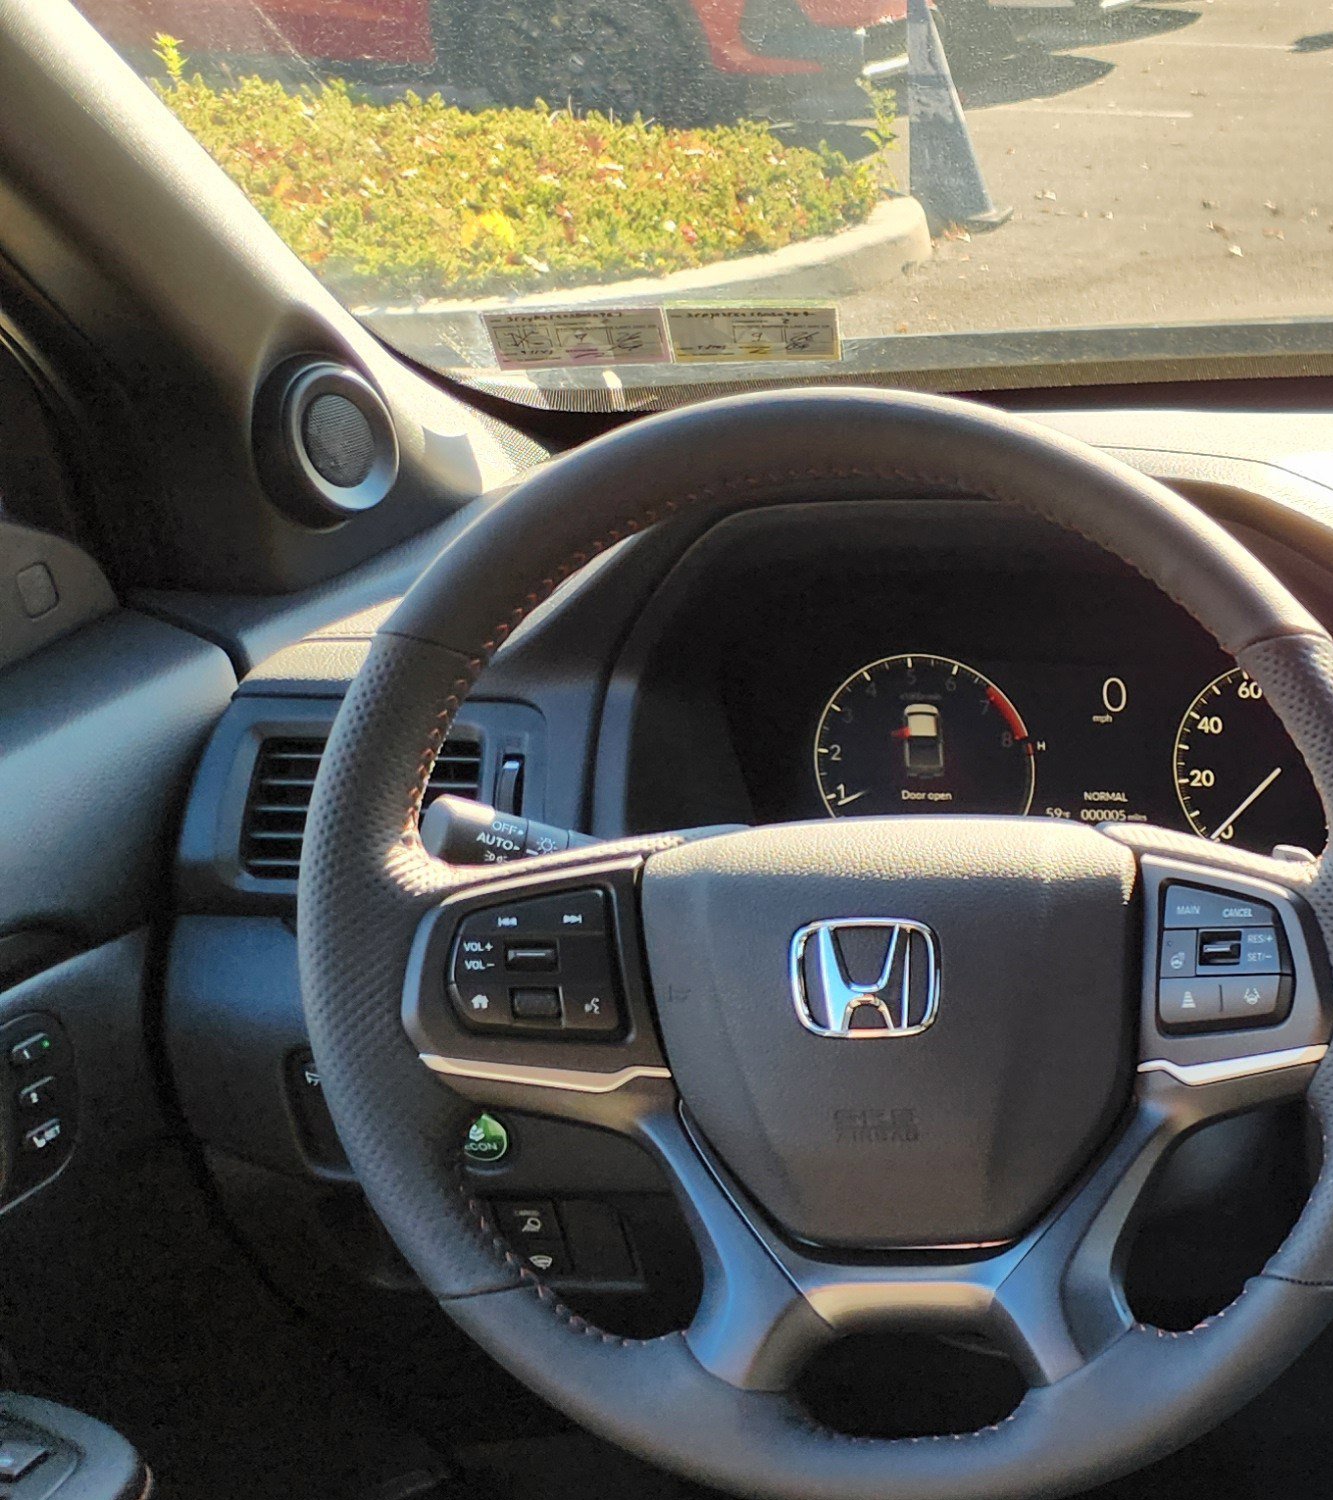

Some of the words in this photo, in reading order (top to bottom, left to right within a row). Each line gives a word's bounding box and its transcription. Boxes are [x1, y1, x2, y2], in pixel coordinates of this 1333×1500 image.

[1103, 677, 1127, 712] 0
[1238, 681, 1262, 699] 60
[1093, 714, 1113, 723] mph
[1198, 716, 1222, 734] 40
[830, 745, 842, 761] 2
[1037, 741, 1046, 751] H
[1190, 770, 1215, 787] 20
[836, 784, 845, 799] 1
[901, 790, 926, 801] Door
[927, 791, 952, 804] open
[1084, 791, 1128, 802] NORMAL
[1081, 809, 1127, 821] 000005
[492, 822, 518, 835] OFF
[477, 832, 514, 851] AUTO
[1176, 905, 1200, 915] MAIN
[1222, 908, 1253, 918] CANCEL
